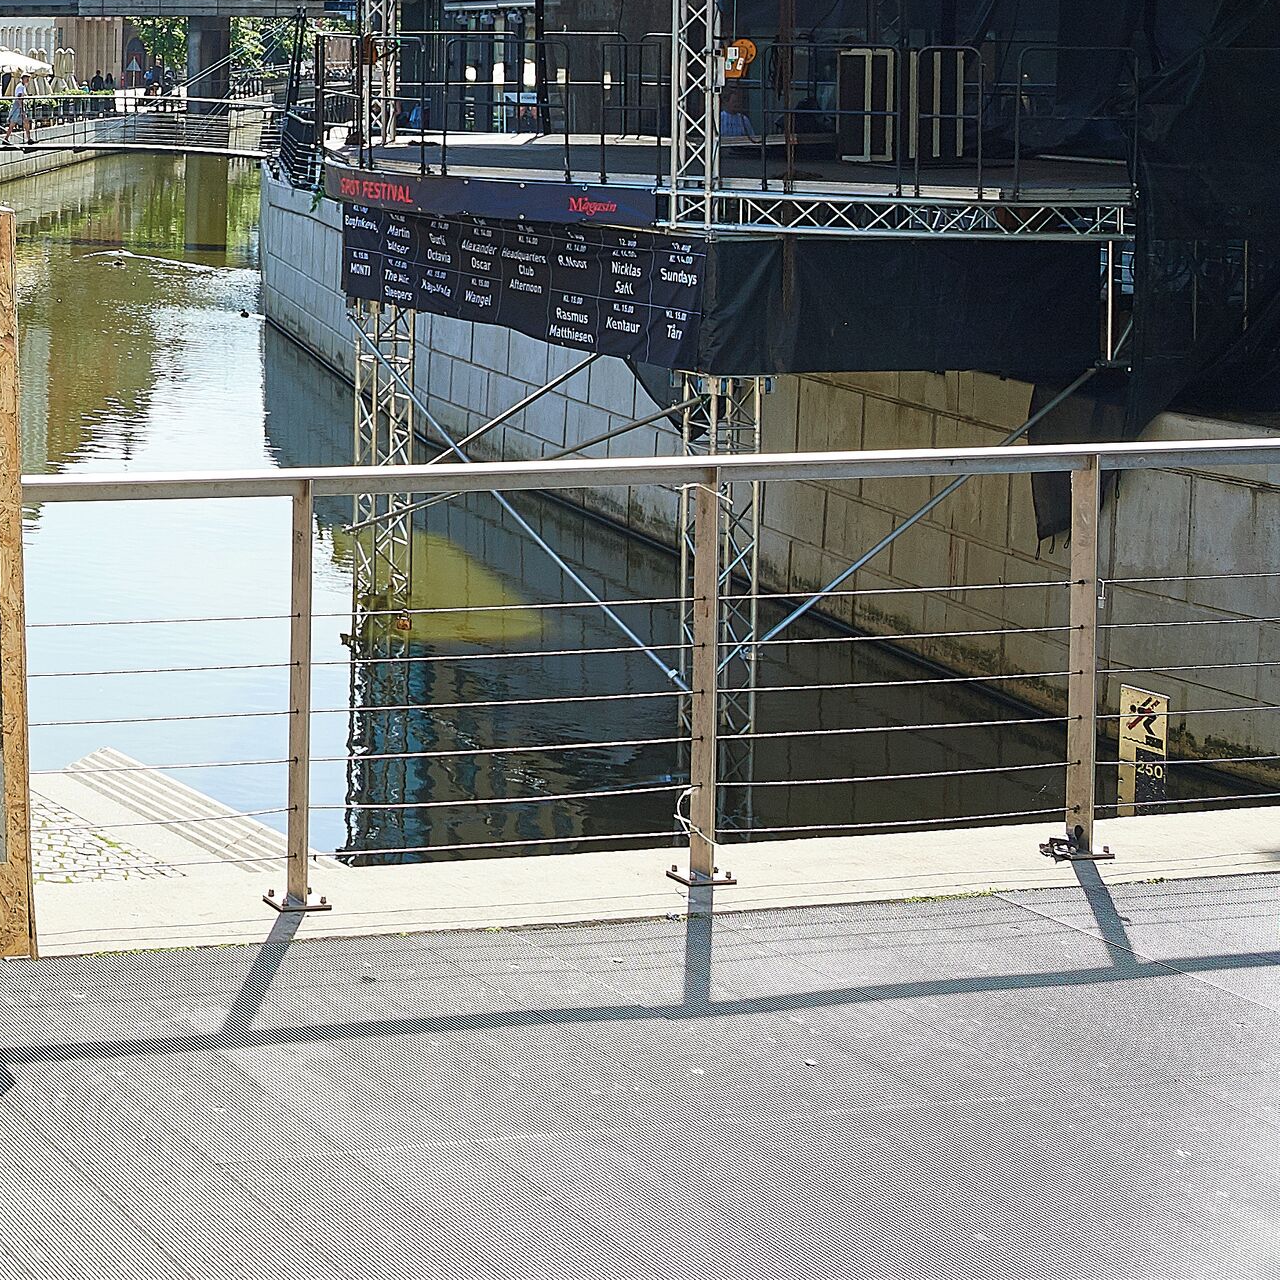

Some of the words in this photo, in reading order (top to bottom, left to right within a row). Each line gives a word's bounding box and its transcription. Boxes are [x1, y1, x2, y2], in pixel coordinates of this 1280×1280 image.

[340, 177, 361, 196] SPOT
[362, 181, 414, 204] FESTIVAL
[568, 196, 618, 216] Magasin
[386, 224, 411, 239] Martin
[427, 248, 452, 264] Octavia
[462, 240, 498, 256] Alexander
[502, 247, 546, 264] Headquarters
[350, 262, 370, 276] MONTI
[472, 257, 492, 271] Oscar
[518, 264, 535, 277] Club
[611, 261, 642, 278] Nicklas
[384, 268, 398, 282] The
[660, 268, 698, 287] Sundays
[384, 286, 413, 302] Sleepers
[509, 278, 542, 294] Afternoon
[464, 290, 492, 308] Wangel
[556, 307, 588, 324] Rasmus
[606, 316, 640, 334] Kentaur
[549, 324, 594, 344] Matthiesen
[1136, 760, 1164, 780] 250
